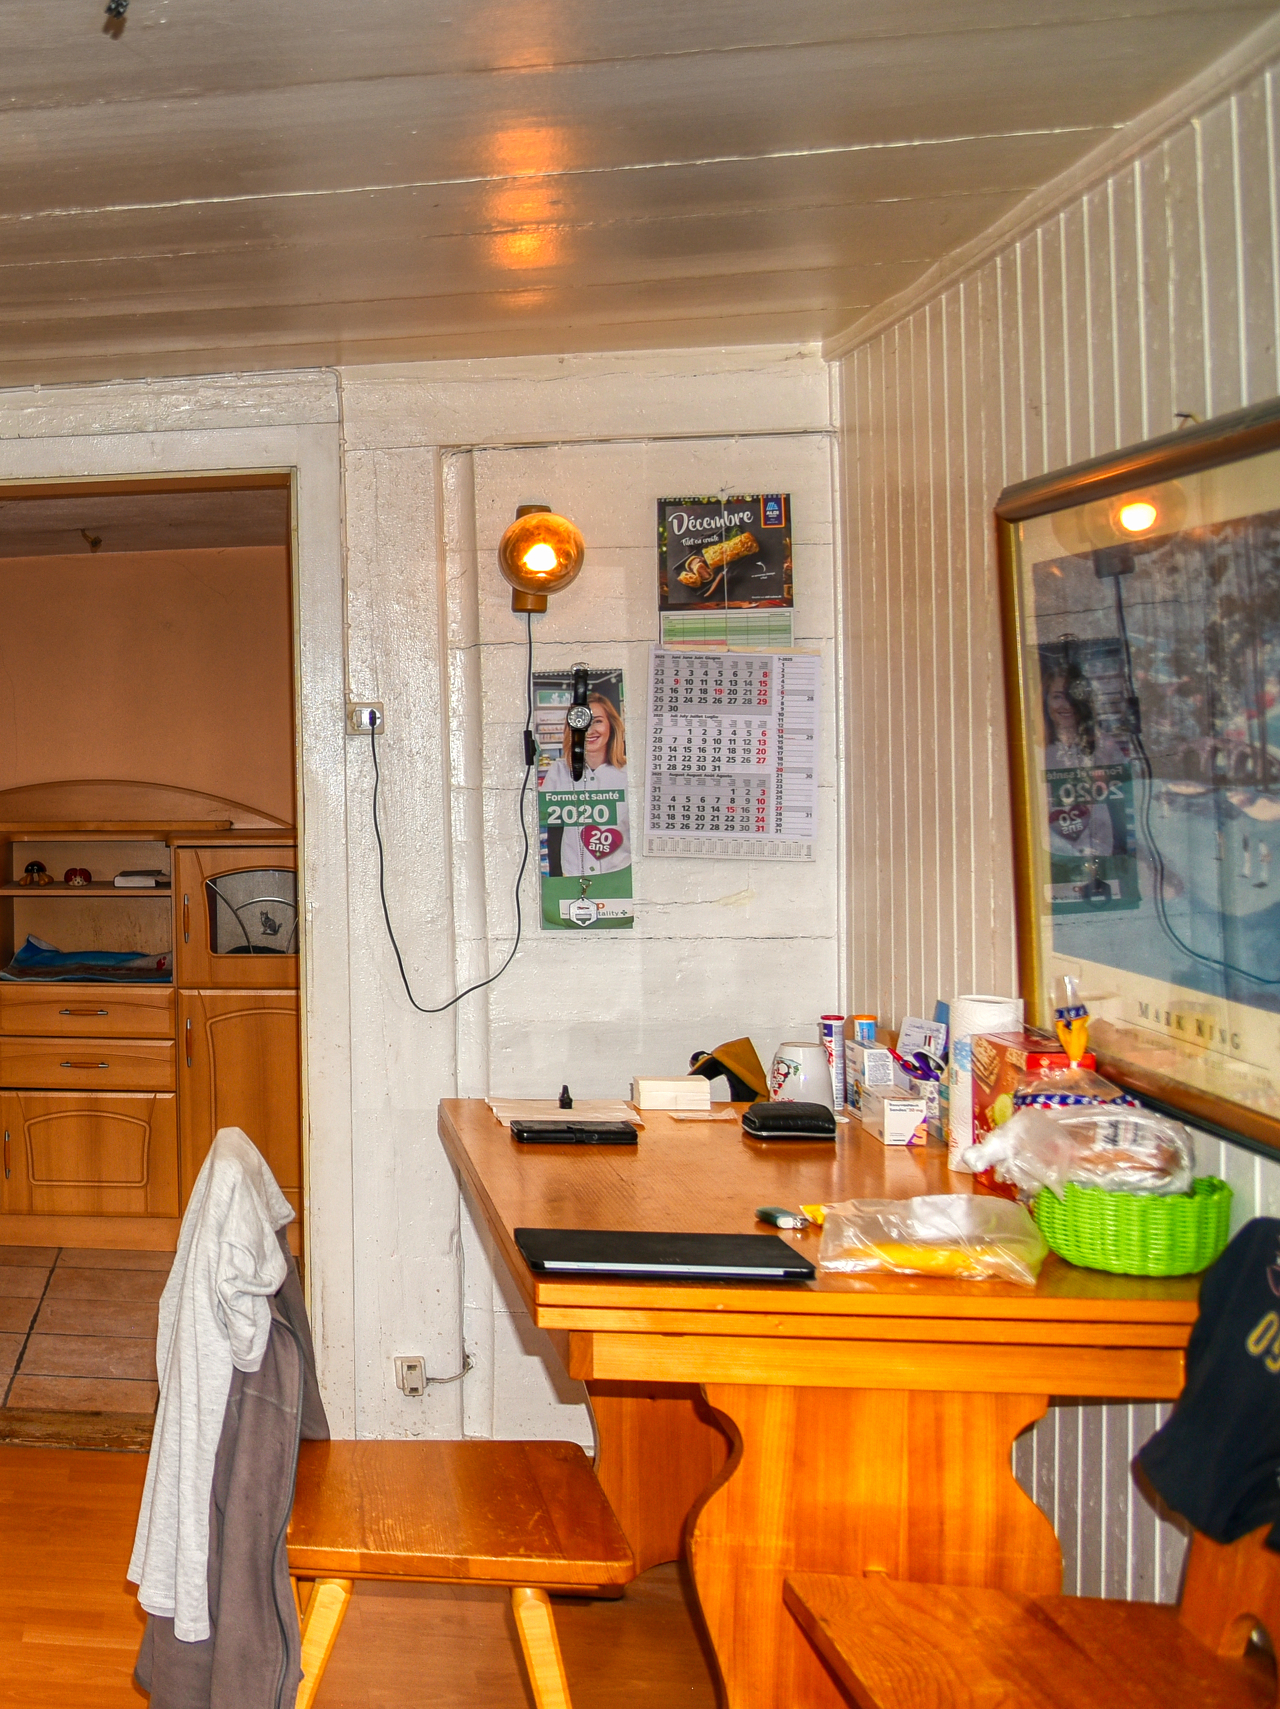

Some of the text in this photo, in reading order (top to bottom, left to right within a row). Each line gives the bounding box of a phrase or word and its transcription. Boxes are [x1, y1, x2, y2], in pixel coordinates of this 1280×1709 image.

[668, 511, 753, 535] Décembre
[546, 791, 619, 801] Forme et santé
[547, 805, 609, 824] 2020
[590, 830, 612, 844] 20
[589, 842, 610, 852] ans
[1138, 1001, 1240, 1050] MARK KING
